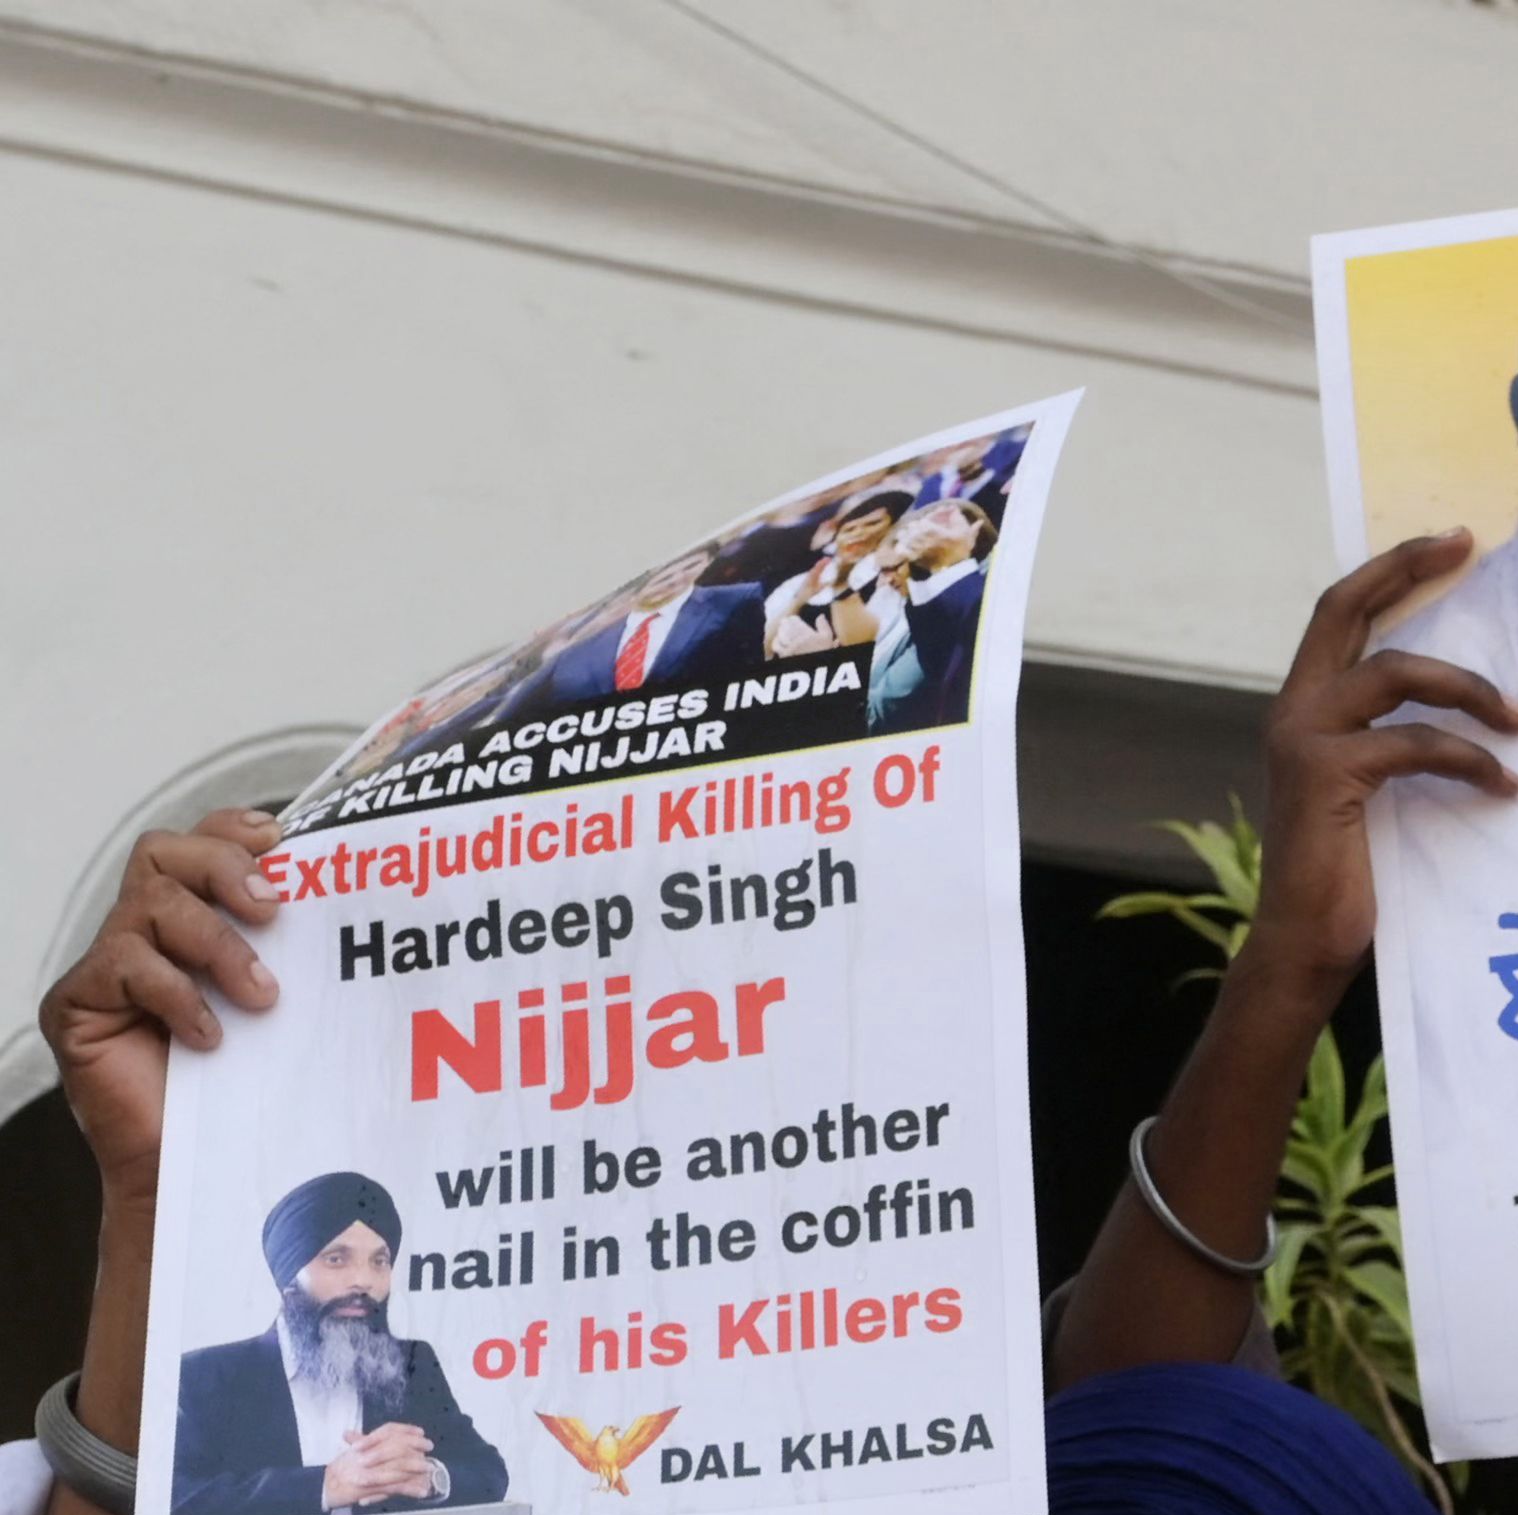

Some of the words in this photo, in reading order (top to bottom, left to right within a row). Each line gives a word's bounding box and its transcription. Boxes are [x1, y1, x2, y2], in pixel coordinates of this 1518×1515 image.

[478, 689, 708, 757] ACCUSES
[723, 661, 862, 714] INDIA
[339, 755, 532, 818] KILLING
[549, 720, 727, 779] NIJJAR
[262, 794, 633, 903] Extrajudicial
[658, 763, 852, 844] Killing
[873, 745, 941, 810] Of
[339, 886, 634, 981] Hardeep
[661, 847, 858, 932] Singh
[410, 976, 785, 1110] Nijjar
[437, 1144, 555, 1210] will
[583, 1138, 662, 1193] be
[687, 1101, 950, 1182] another
[408, 1231, 534, 1292] nail
[562, 1224, 620, 1282] in
[646, 1208, 756, 1271] the
[781, 1179, 974, 1256] coffin
[472, 1320, 548, 1381] of
[579, 1310, 687, 1374] his
[717, 1285, 962, 1360] Killers
[660, 1441, 761, 1485] DAL
[781, 1414, 993, 1474] KHALSA
